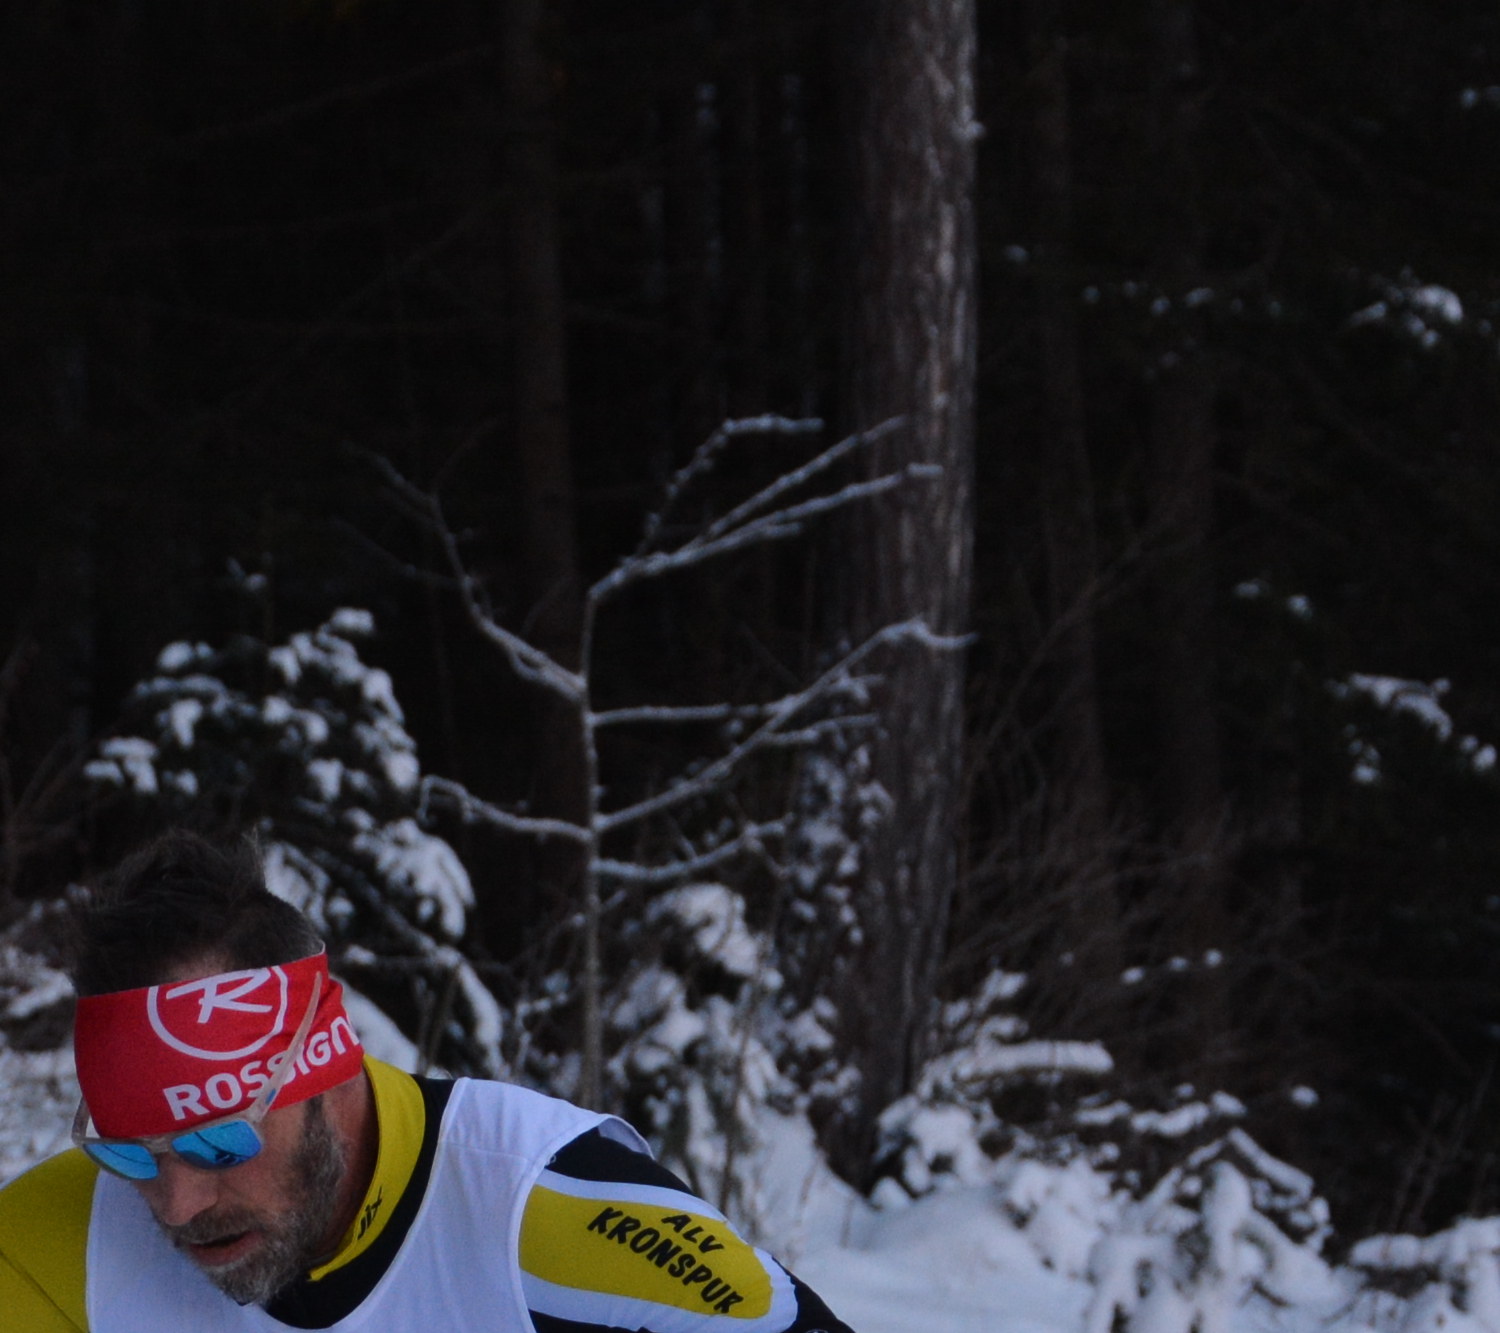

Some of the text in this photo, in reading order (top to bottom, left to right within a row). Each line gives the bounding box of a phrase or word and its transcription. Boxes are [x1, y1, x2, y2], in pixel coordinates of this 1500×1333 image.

[162, 1012, 362, 1122] ROSSIGN
[587, 1206, 744, 1315] KRONSPUR
[661, 1213, 725, 1254] ALV
